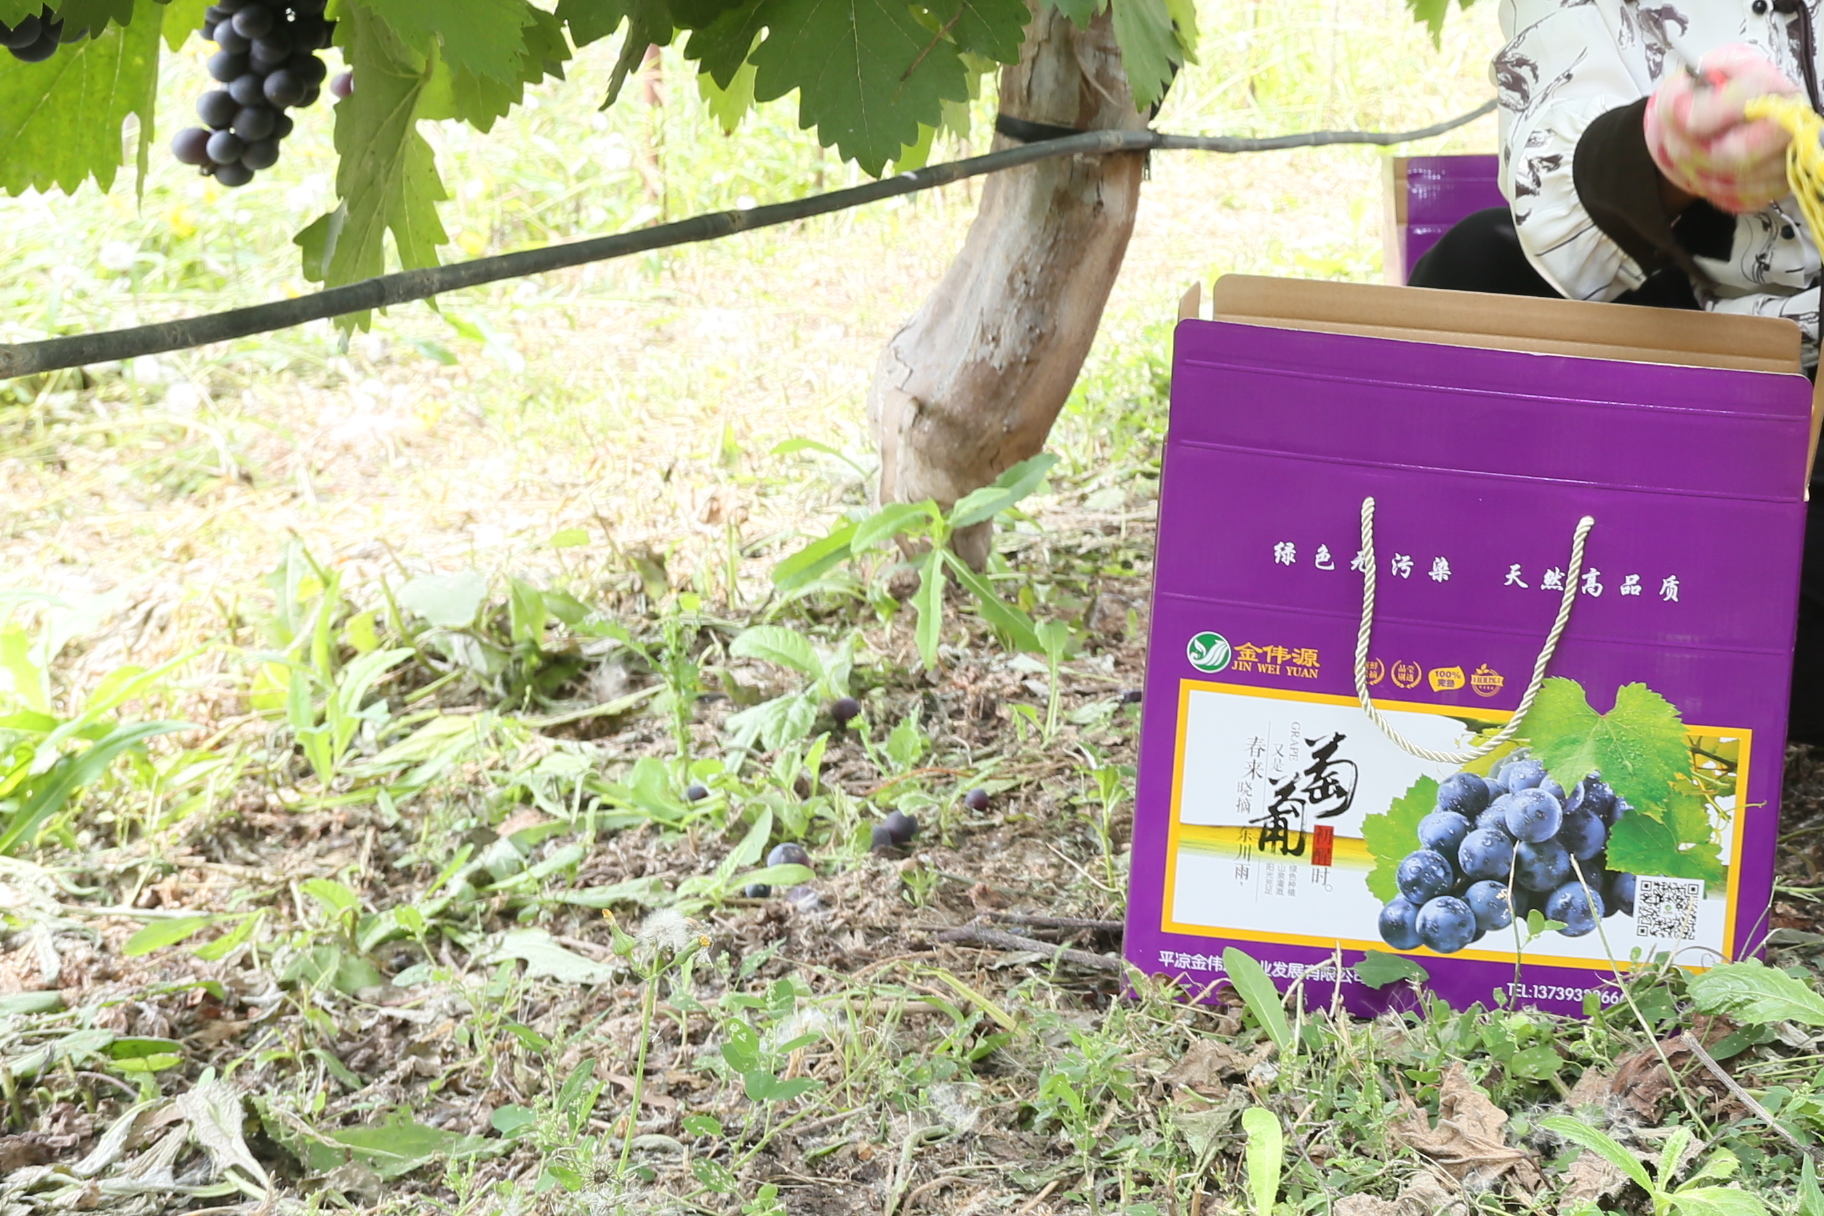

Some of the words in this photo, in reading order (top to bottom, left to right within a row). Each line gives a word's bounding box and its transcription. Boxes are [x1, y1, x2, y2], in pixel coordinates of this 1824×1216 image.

[1503, 563, 1681, 602] 天然高品质
[1233, 642, 1321, 667] 金伟源
[1231, 660, 1252, 672] JIN
[1257, 664, 1281, 675] WEI
[1286, 666, 1319, 678] YUAN
[1435, 670, 1461, 679] 100%
[1289, 721, 1301, 761] GRAPE
